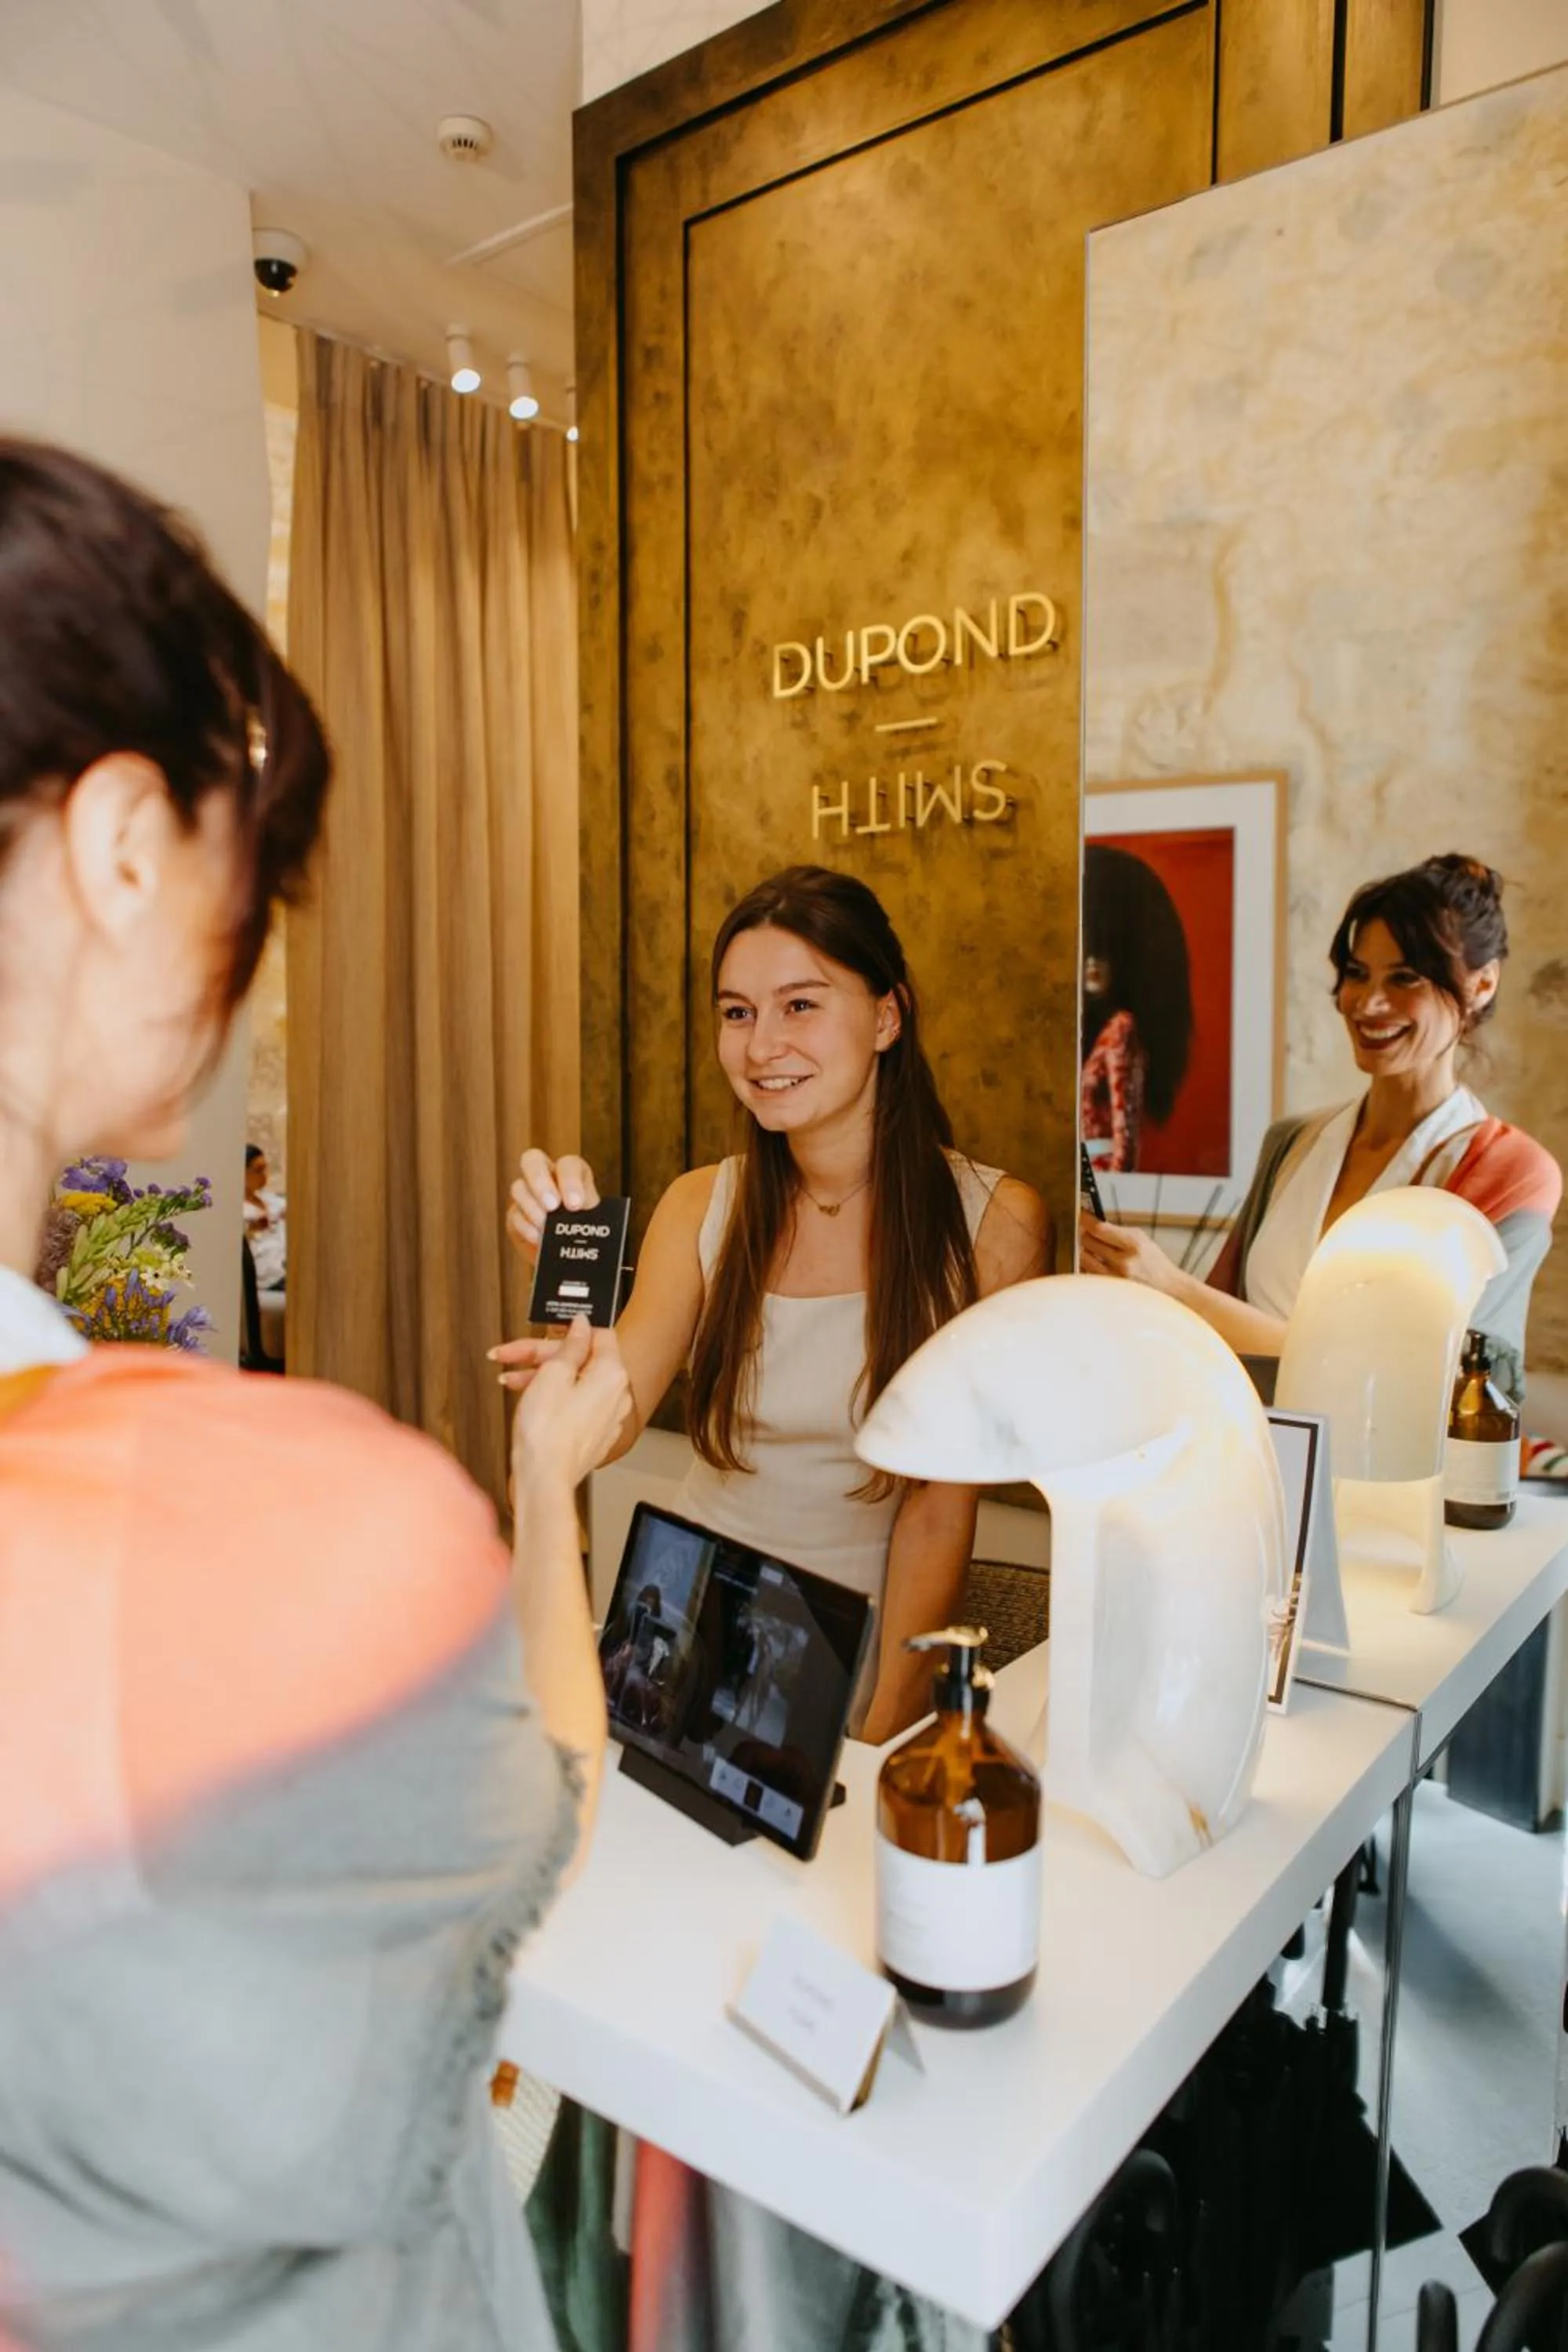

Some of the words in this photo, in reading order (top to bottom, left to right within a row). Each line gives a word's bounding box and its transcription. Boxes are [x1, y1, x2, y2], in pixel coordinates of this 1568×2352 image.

[773, 592, 1056, 699] DUPOND
[811, 760, 1007, 839] SMITH
[555, 1223, 610, 1237] DUPOND
[560, 1247, 599, 1260] SMITH
